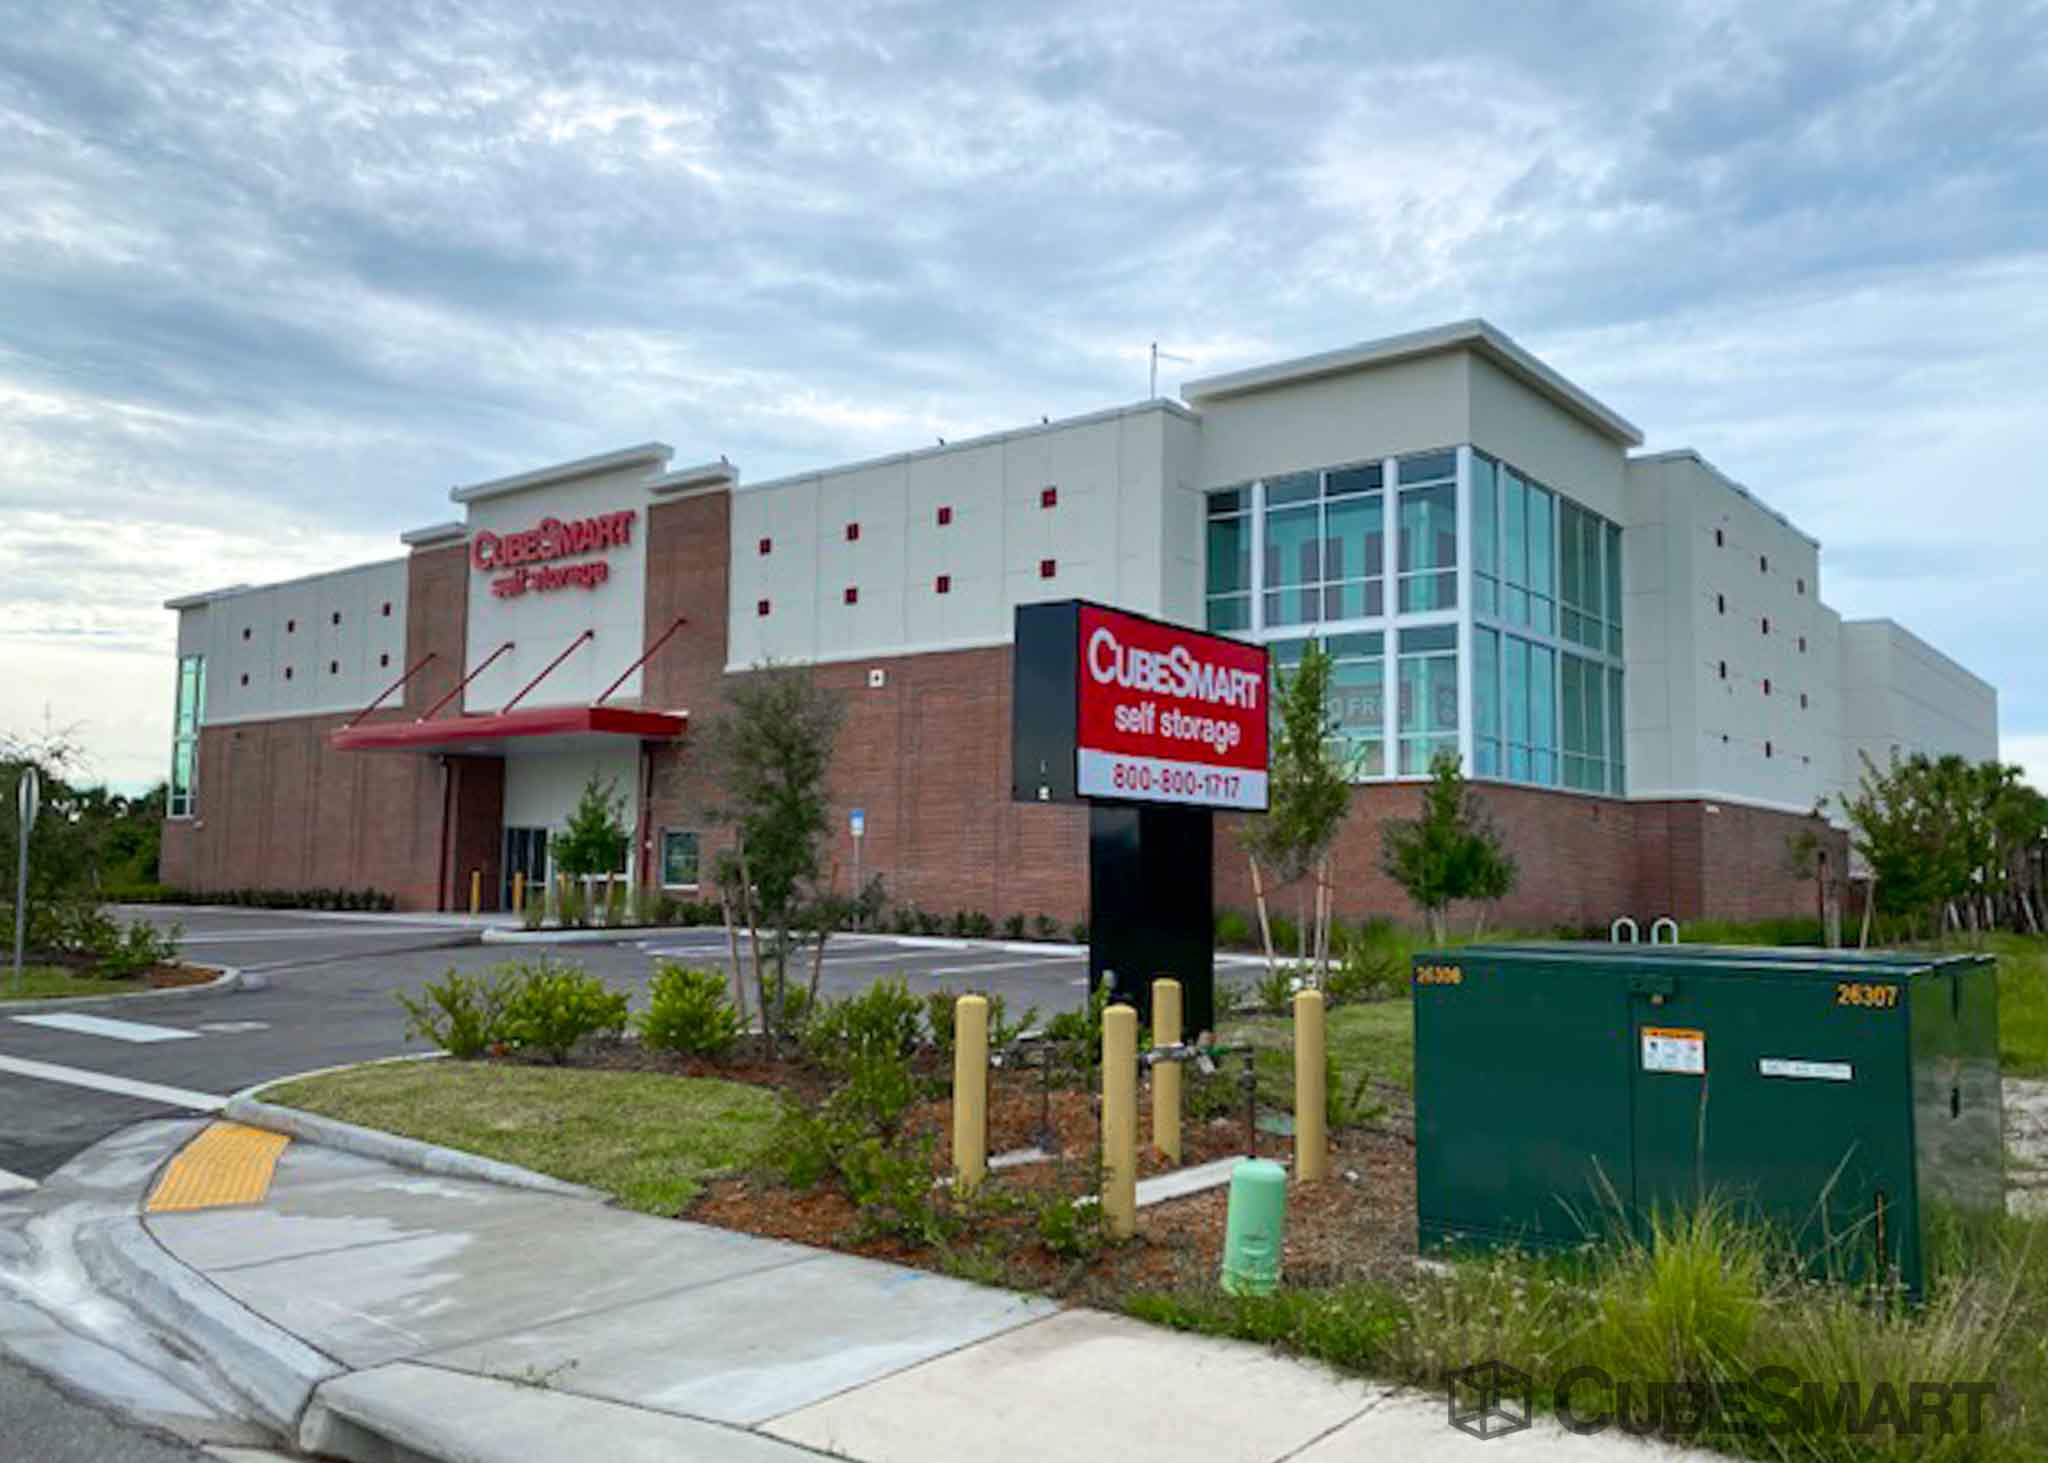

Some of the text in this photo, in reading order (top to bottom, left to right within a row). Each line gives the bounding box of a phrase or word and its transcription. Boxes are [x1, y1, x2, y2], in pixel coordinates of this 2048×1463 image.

[1114, 701, 1241, 755] self storage
[1113, 763, 1241, 799] 800-800-1717
[1837, 983, 1898, 1008] 26307
